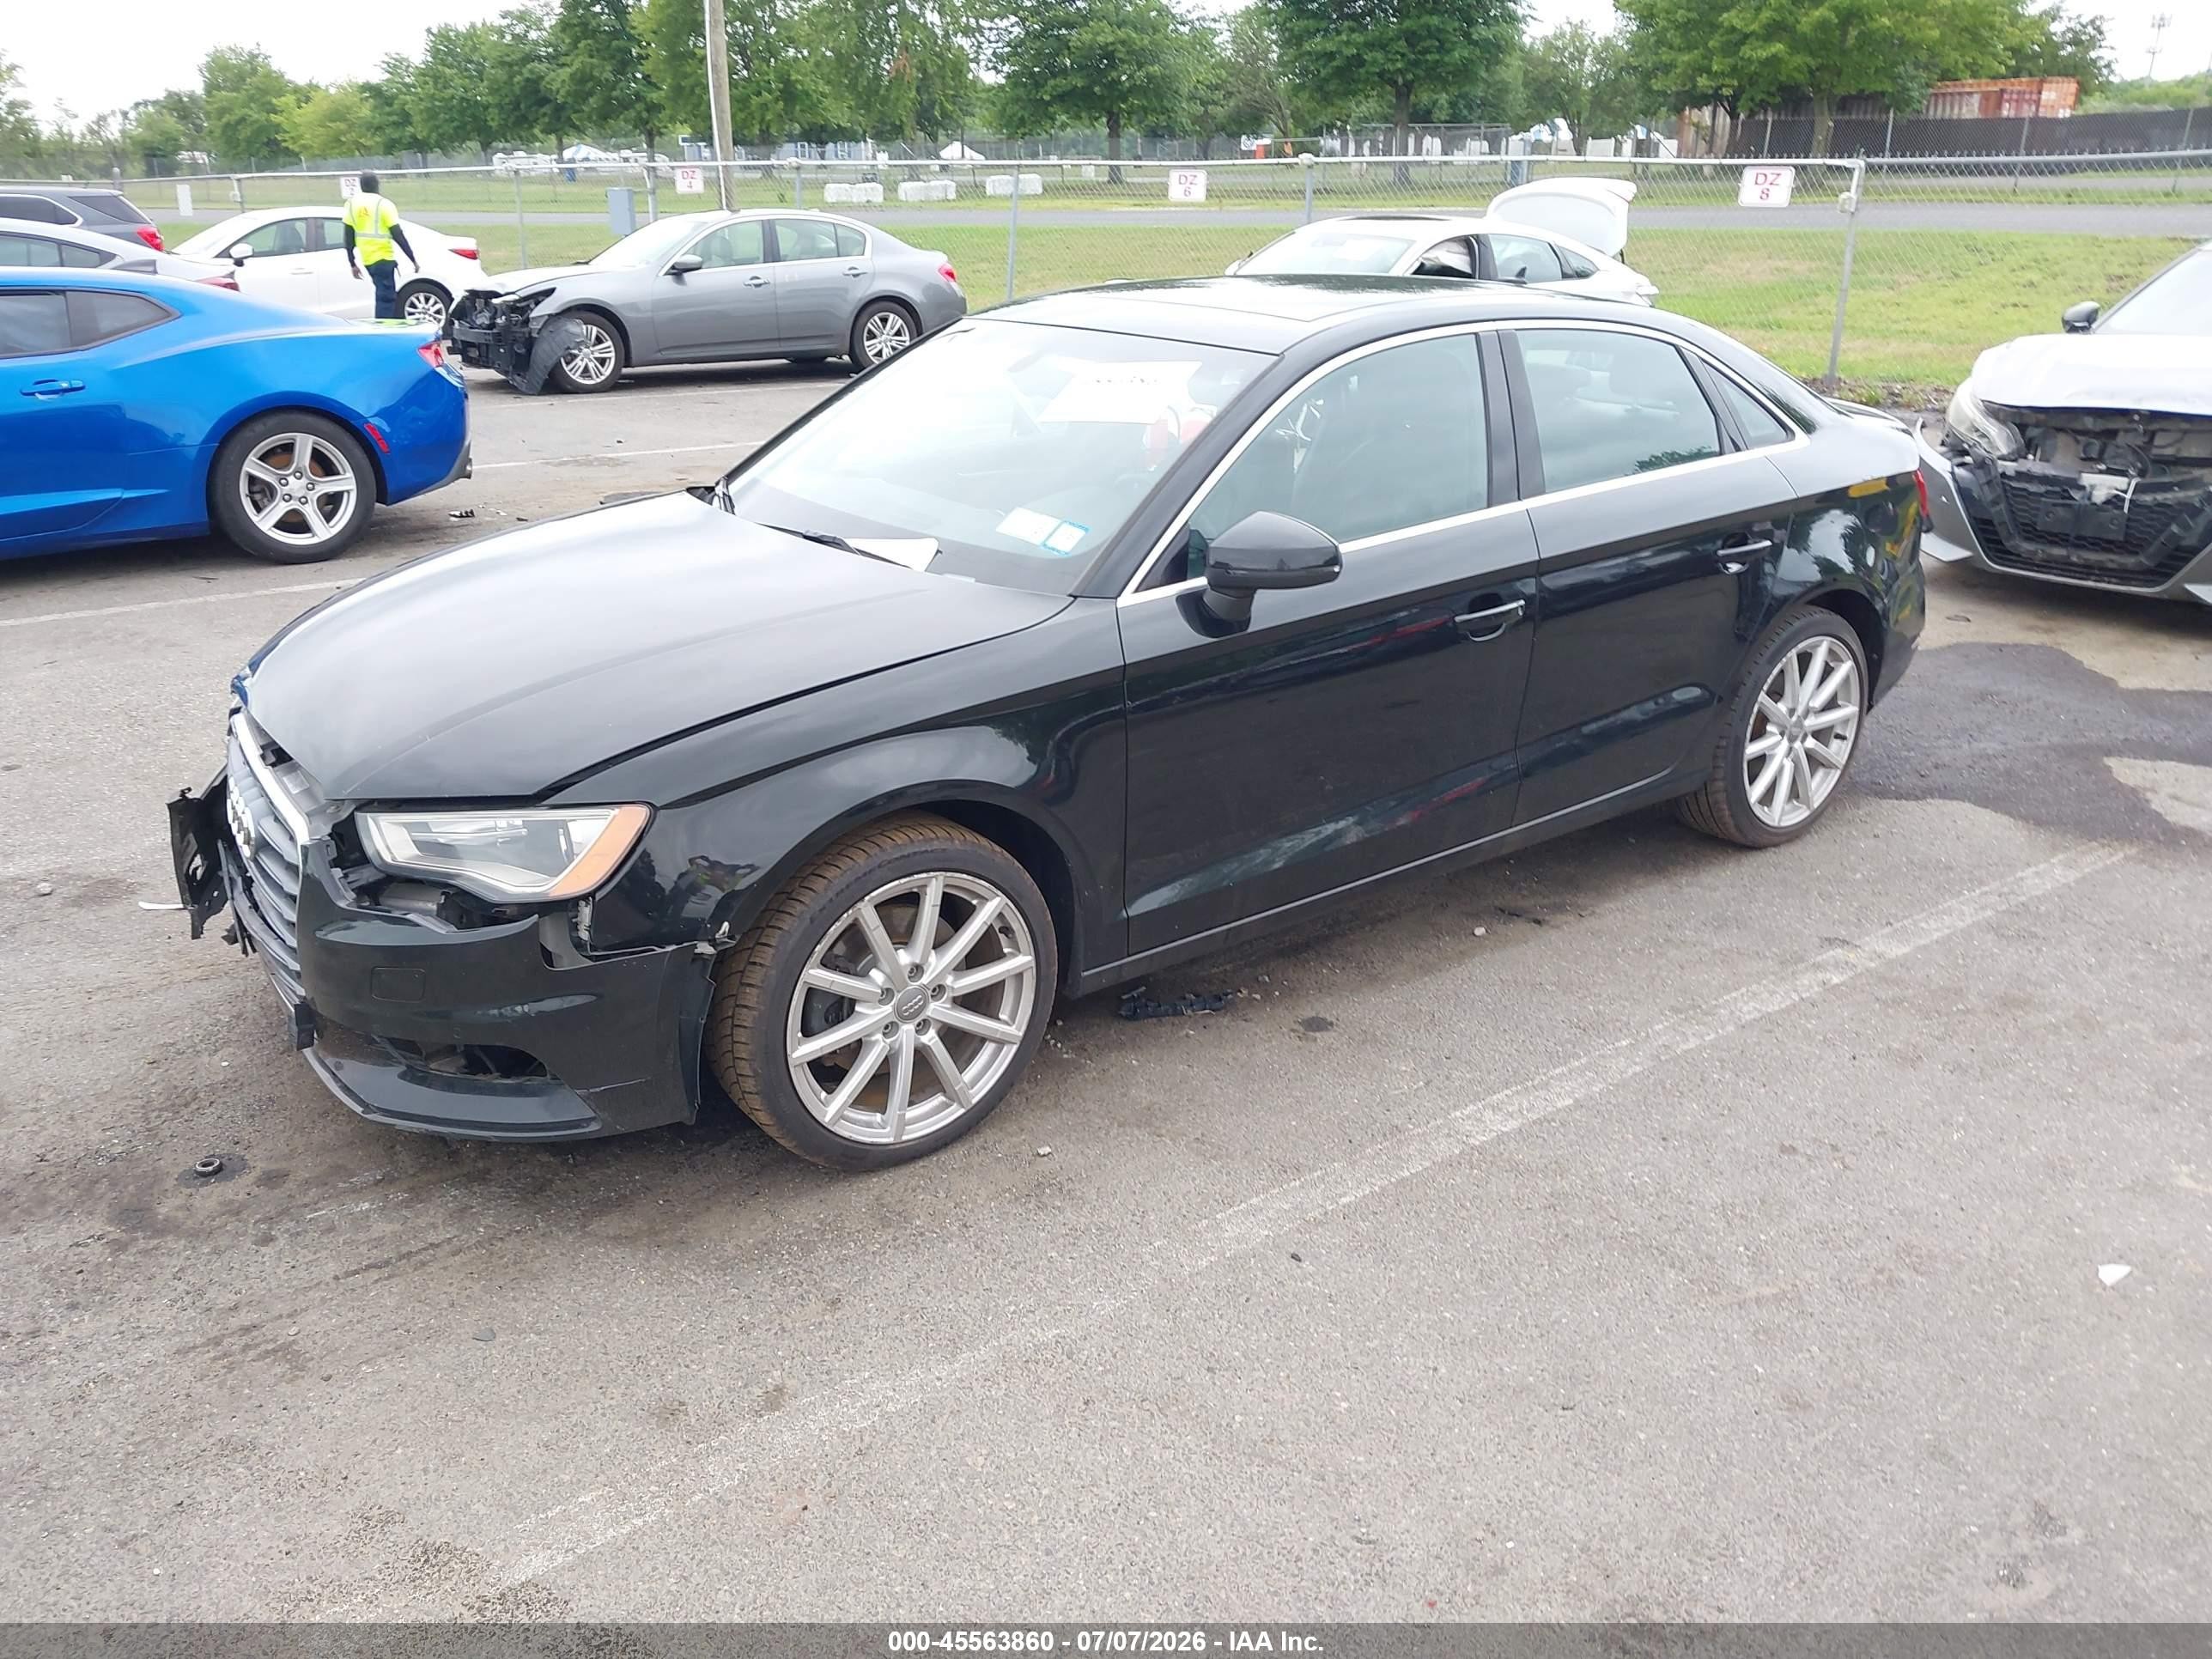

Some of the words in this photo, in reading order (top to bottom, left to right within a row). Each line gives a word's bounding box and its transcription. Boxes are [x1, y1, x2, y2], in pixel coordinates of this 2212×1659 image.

[681, 170, 696, 179] DZ
[1178, 174, 1198, 185] DZ
[1754, 172, 1782, 186] DZ
[344, 178, 357, 187] DZ
[686, 180, 693, 189] 4
[1183, 186, 1192, 198] 6
[1759, 187, 1771, 201] 8
